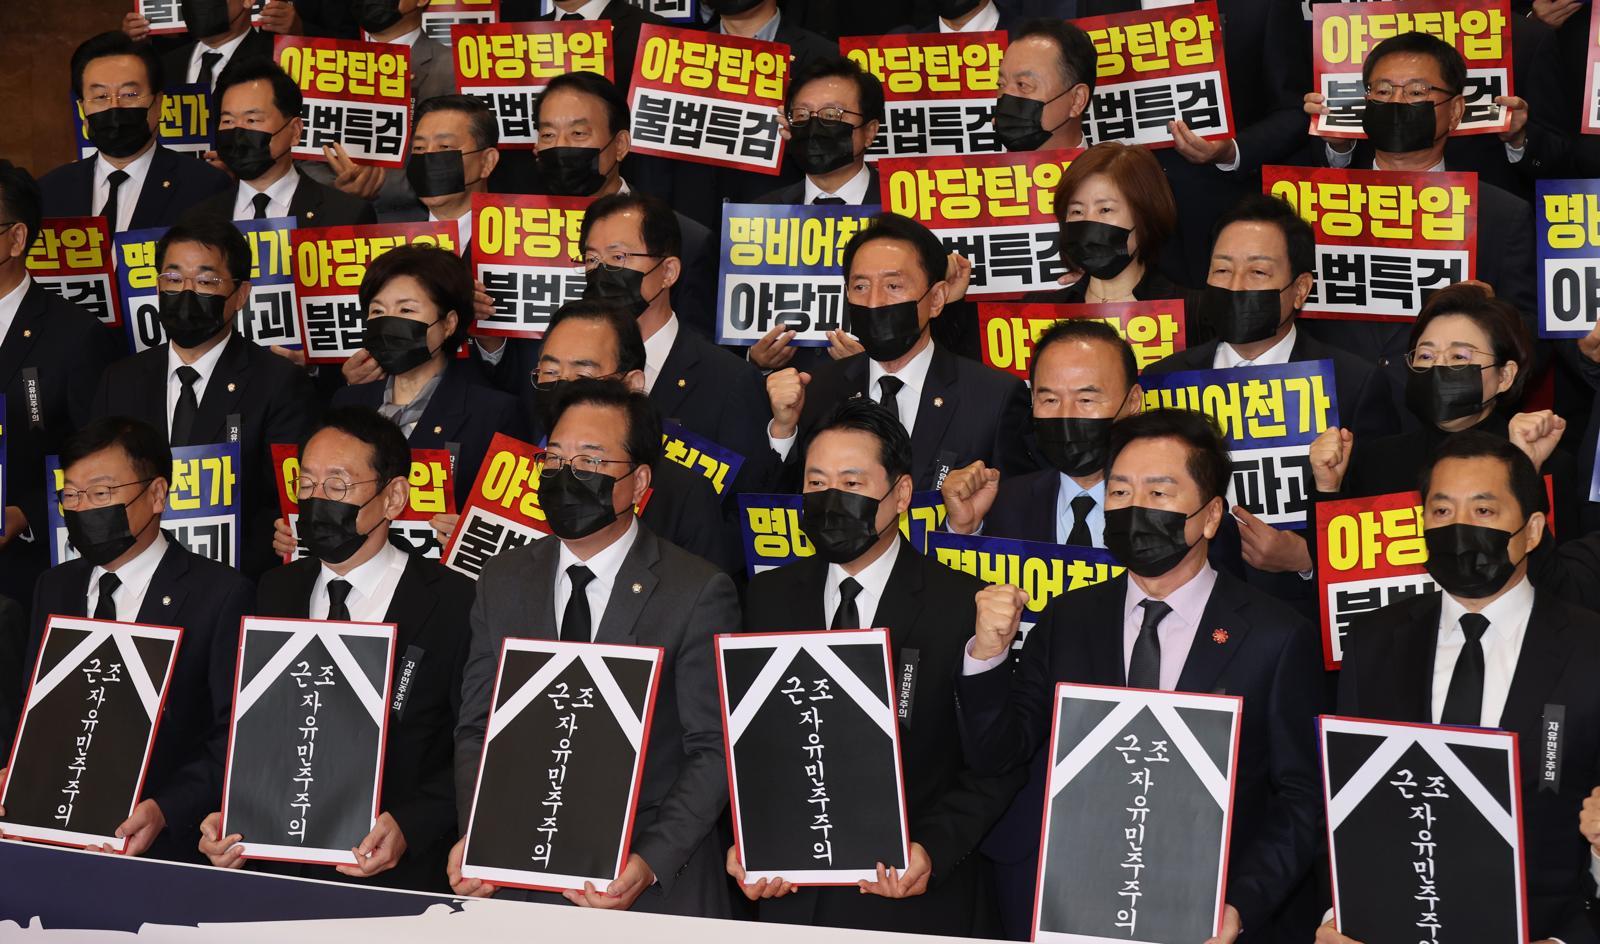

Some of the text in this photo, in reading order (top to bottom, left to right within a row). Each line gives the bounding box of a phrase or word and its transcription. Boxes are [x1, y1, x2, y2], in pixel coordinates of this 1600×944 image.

[280, 47, 407, 98] 야당탄압
[458, 32, 608, 79] 야당탄압
[641, 37, 787, 100] 야당탄압
[1087, 15, 1215, 77] 당탄압
[297, 103, 403, 155] 법특검
[632, 94, 777, 160] 불법특검
[1082, 79, 1222, 146] 법특검
[1306, 253, 1462, 309] 법특검
[83, 658, 122, 683] 근조
[290, 660, 336, 688] 근조
[392, 660, 416, 711] 자유민주주의
[547, 681, 595, 710] 근조
[780, 675, 834, 705] 근조
[898, 663, 914, 718] 자유민주주의
[54, 686, 106, 827] 자유민주주의
[288, 691, 322, 843] 자유민주주의
[1115, 734, 1171, 764] 근조
[1544, 721, 1560, 781] 자유민주주의
[531, 713, 579, 869] 자유민주주의
[799, 707, 833, 867] 자유민주주의
[1389, 768, 1450, 799] 근조
[1113, 767, 1155, 937] 자유민주주의
